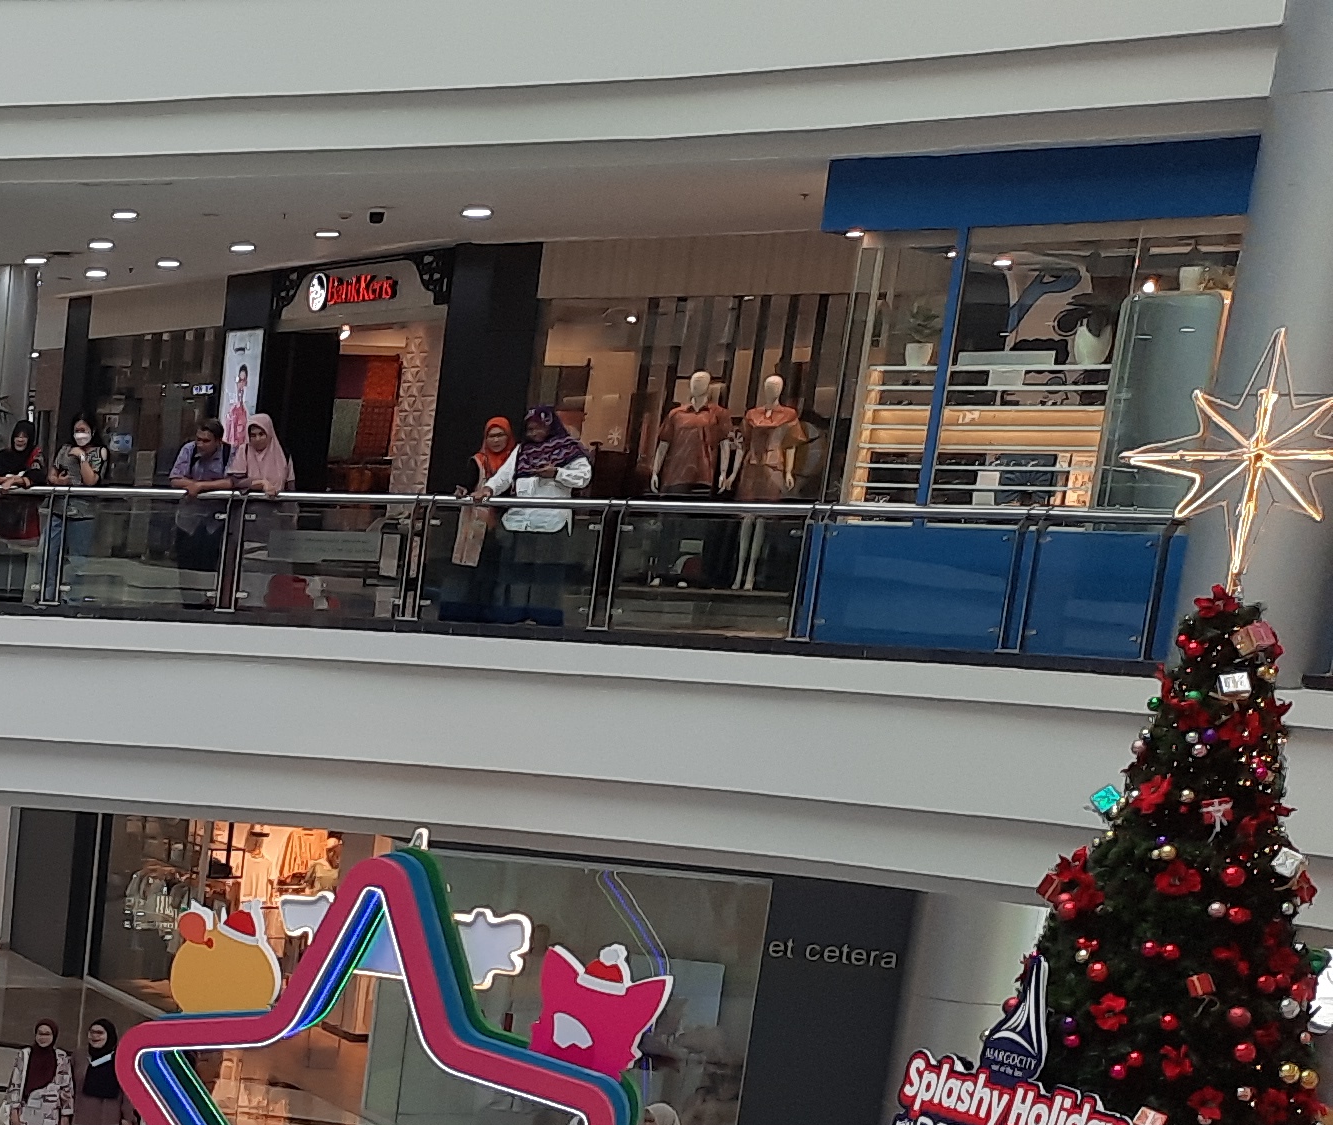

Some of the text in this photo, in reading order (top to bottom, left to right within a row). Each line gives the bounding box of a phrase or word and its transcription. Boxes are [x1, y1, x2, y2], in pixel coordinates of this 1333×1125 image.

[768, 938, 897, 969] et cetera
[985, 1047, 1037, 1070] MARGOCITY
